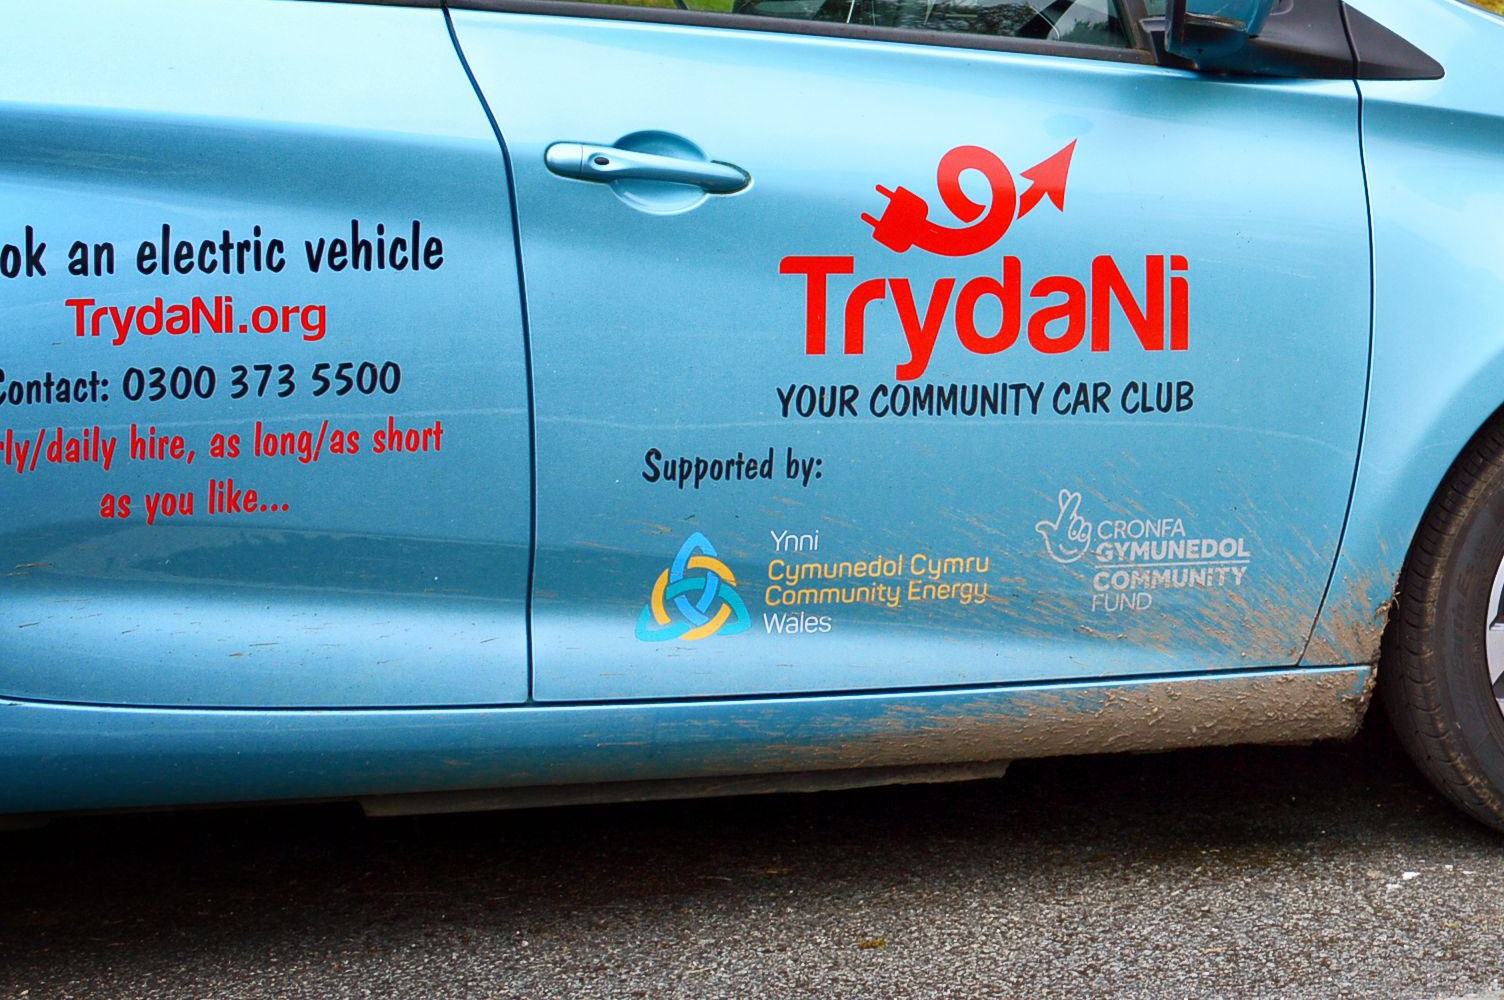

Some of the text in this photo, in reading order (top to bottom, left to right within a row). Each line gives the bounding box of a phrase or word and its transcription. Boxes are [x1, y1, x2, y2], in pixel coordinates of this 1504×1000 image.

[0, 219, 445, 278] ok an electric vehicle
[65, 295, 327, 346] TrydaNi.org
[779, 254, 1190, 382] TrydaNi
[122, 365, 217, 402] 0300
[229, 362, 296, 399] 373
[311, 360, 402, 398] 5500
[776, 380, 1195, 419] YOUR COMMUNITY CAR CLUB
[130, 424, 195, 465] hire,
[209, 432, 240, 459] as
[254, 419, 360, 462] long/as
[372, 415, 444, 453] short
[642, 447, 823, 490] Supported by:
[100, 479, 290, 526] as you like...
[770, 529, 820, 552] Ynni
[1097, 518, 1186, 540] CRONFA
[1095, 538, 1251, 562] GYMUNEDOL
[768, 553, 990, 586] Cymunedol Cymru
[1092, 566, 1248, 592] COMMUNITY
[765, 580, 989, 608] Community Energy
[1091, 592, 1153, 613] FUND
[762, 611, 832, 635] Wales
